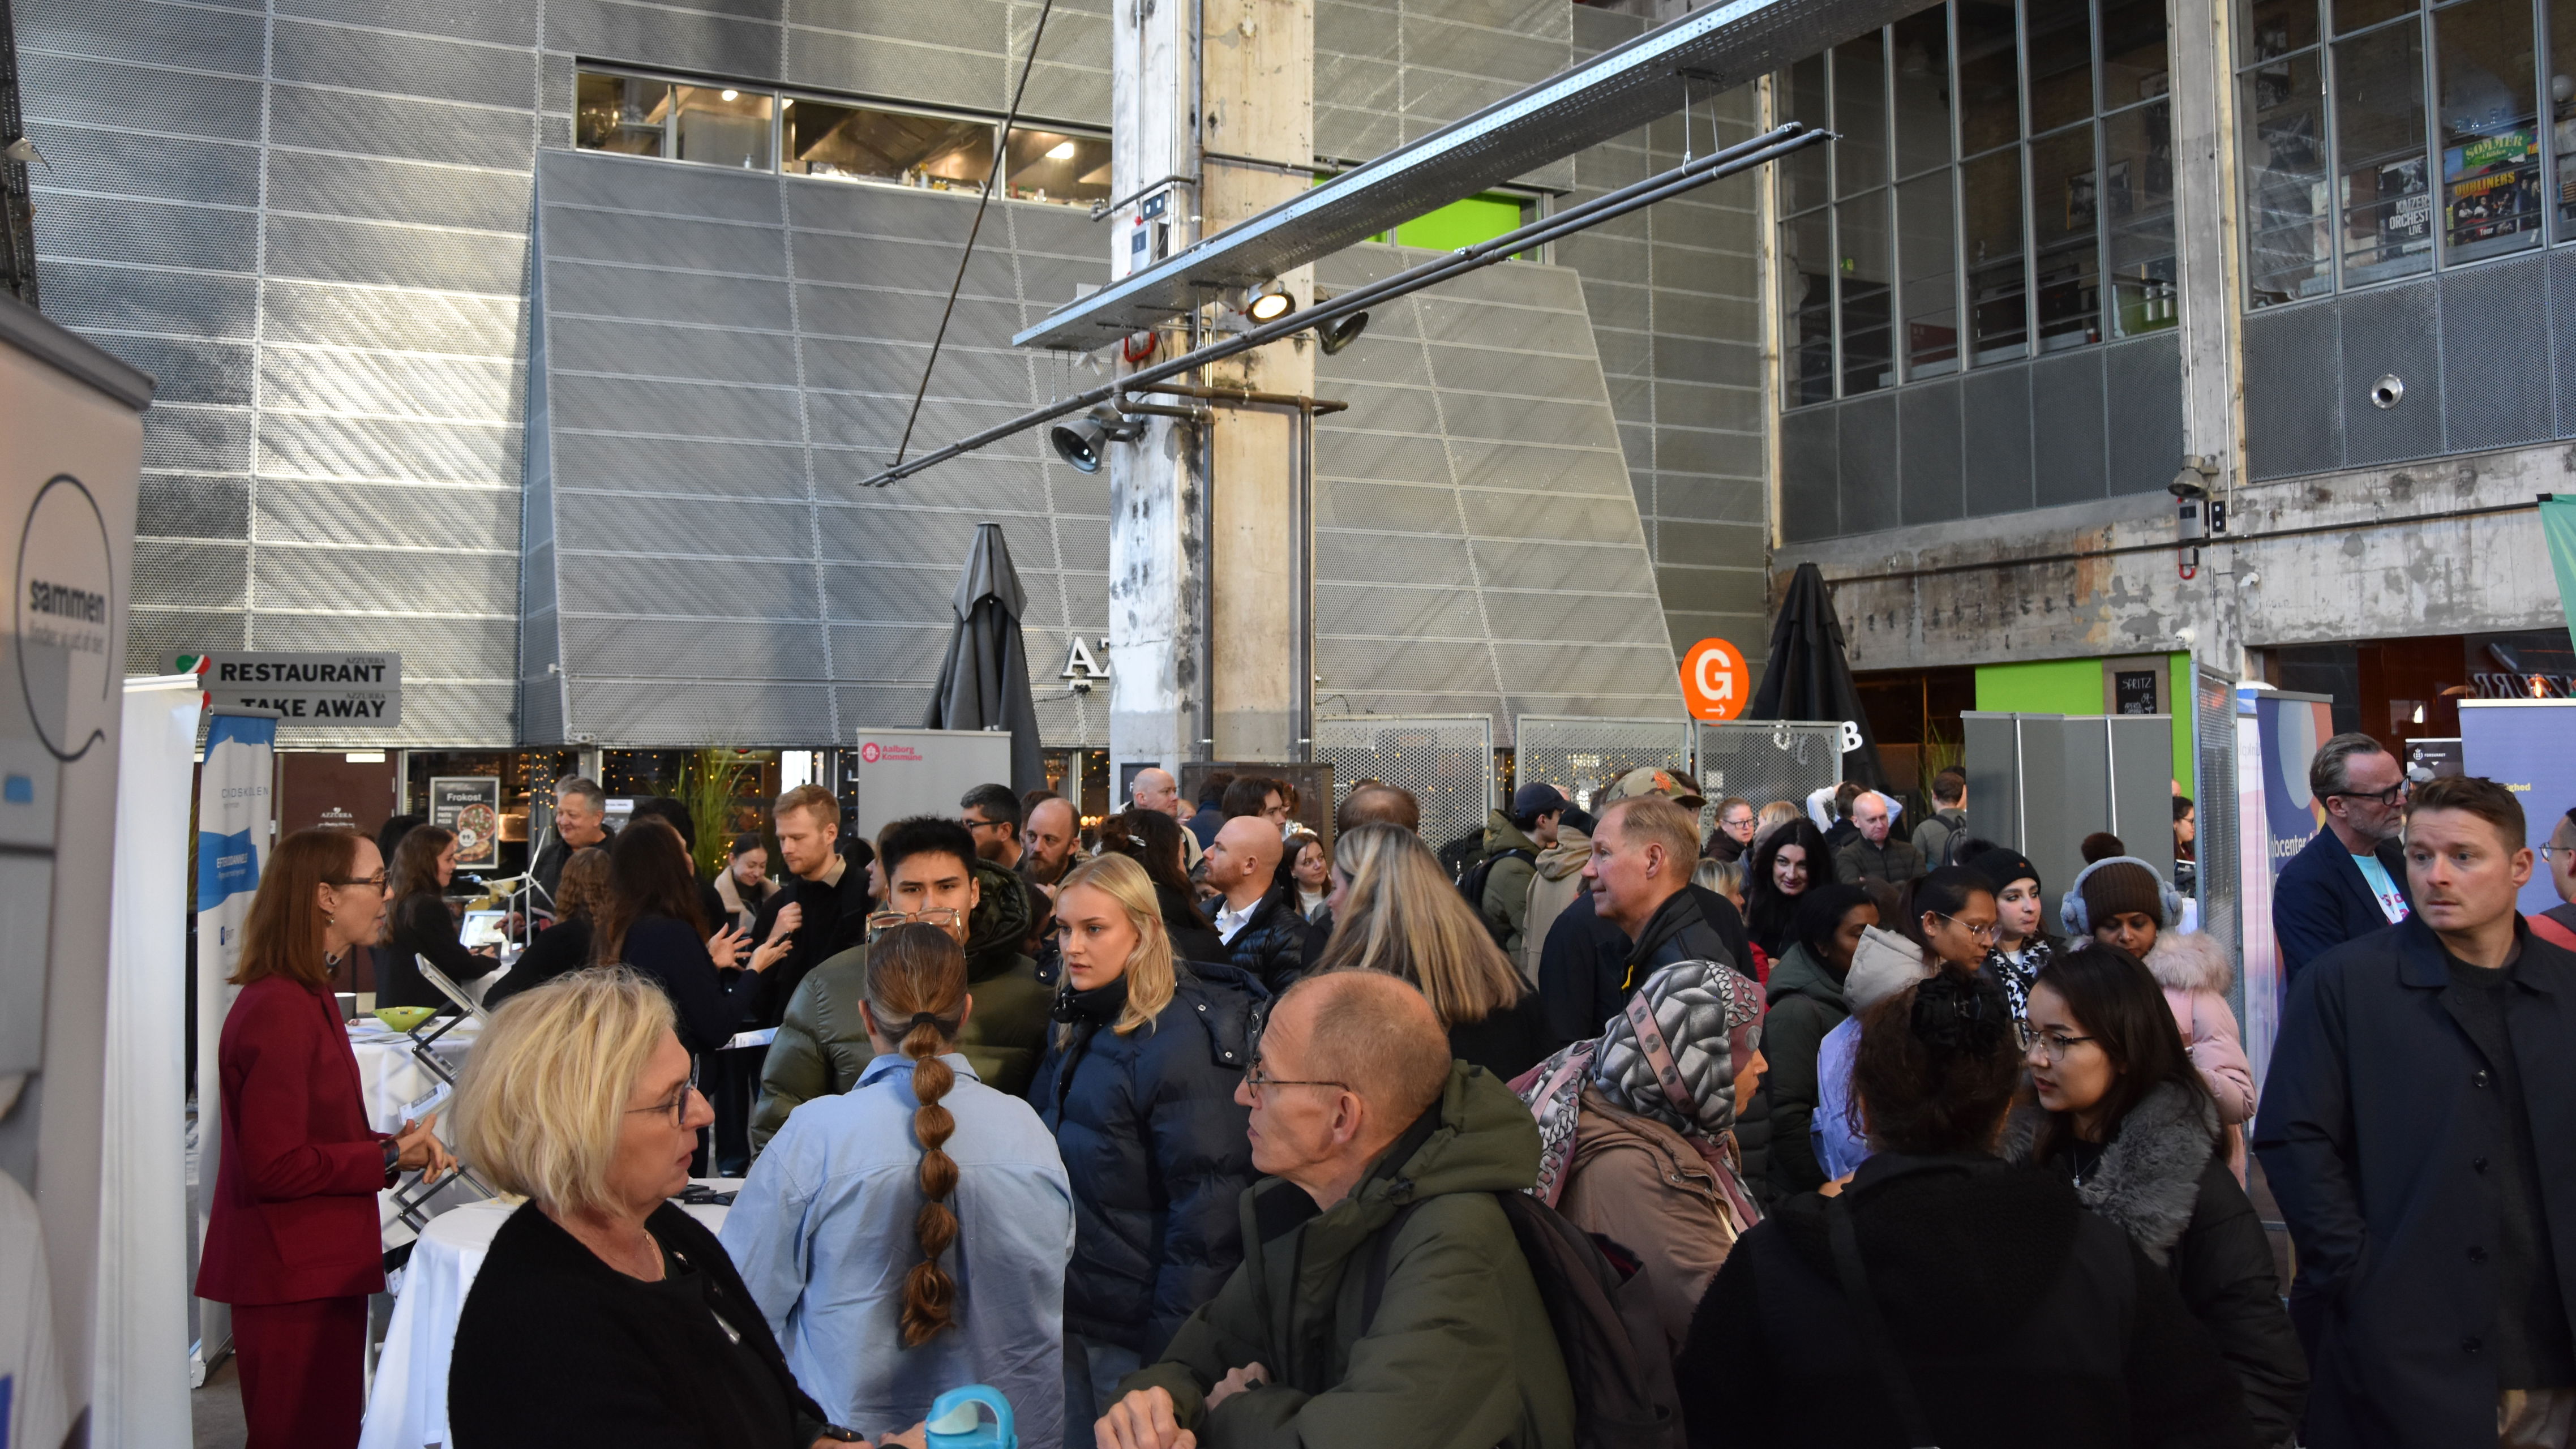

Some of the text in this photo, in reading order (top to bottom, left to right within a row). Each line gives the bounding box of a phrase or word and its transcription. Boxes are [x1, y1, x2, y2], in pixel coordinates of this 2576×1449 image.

[2466, 136, 2523, 159] SOMMER
[2455, 172, 2515, 196] DUBLINERS
[2389, 208, 2429, 230] ORCHEST
[2408, 224, 2423, 235] LIVE
[31, 580, 106, 624] sammen
[220, 663, 386, 682] RESTAURANT
[1695, 649, 1732, 700] G
[2122, 677, 2151, 689] SPRITZ
[314, 700, 386, 718] AWAY
[882, 745, 915, 754] Aalborg
[447, 792, 482, 801] Frokost
